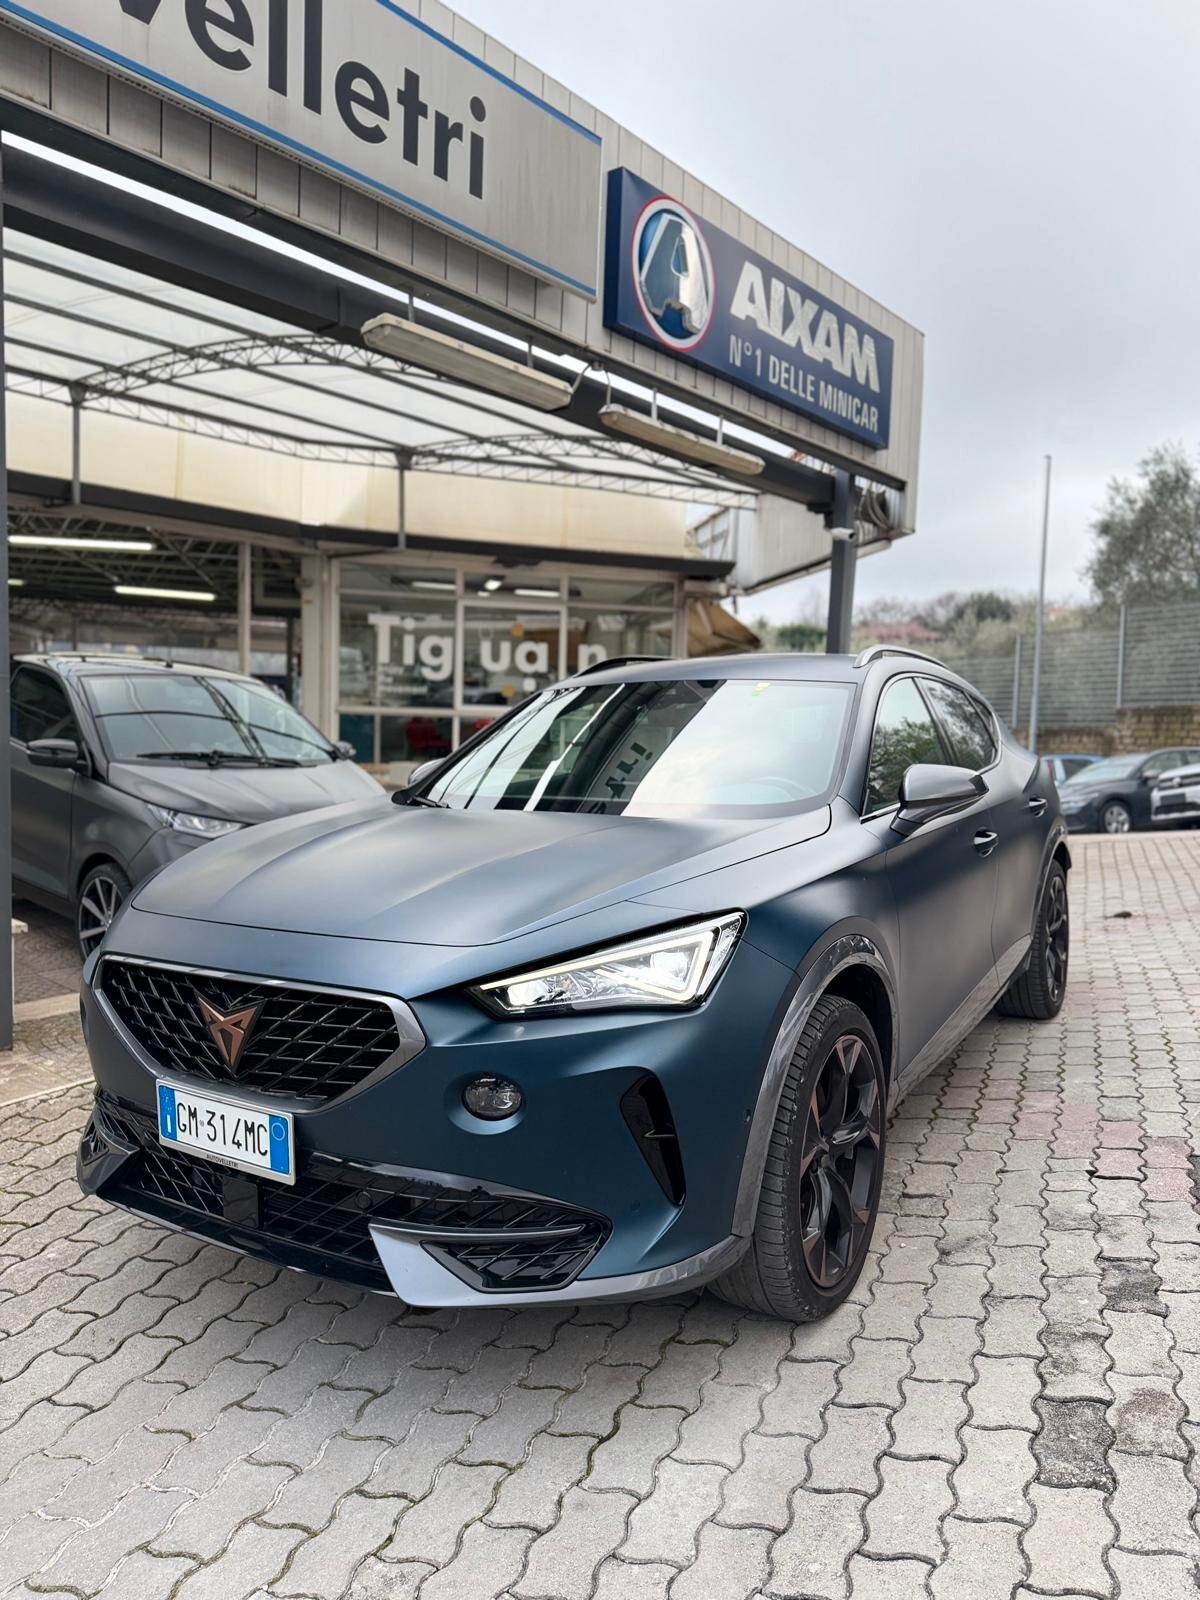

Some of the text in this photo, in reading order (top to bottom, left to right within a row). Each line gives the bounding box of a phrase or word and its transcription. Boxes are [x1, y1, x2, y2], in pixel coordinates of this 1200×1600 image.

[119, 0, 486, 199] elletri
[730, 261, 880, 393] AIXAM
[768, 354, 815, 402] DELLE
[819, 380, 878, 433] MINICAR
